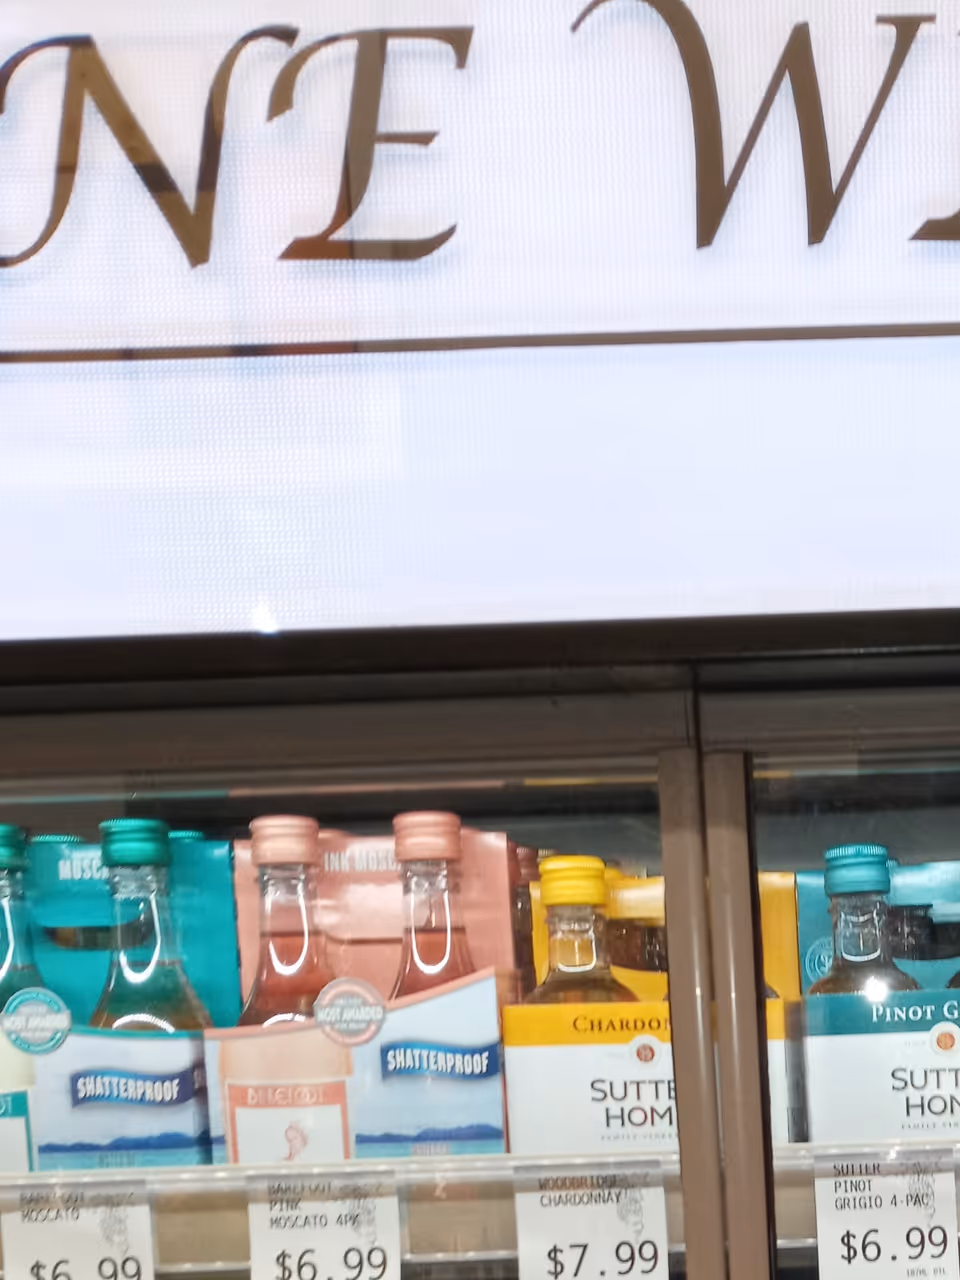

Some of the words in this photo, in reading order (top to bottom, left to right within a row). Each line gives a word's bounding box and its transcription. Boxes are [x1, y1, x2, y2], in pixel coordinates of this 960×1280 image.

[871, 1003, 935, 1022] PINOT
[387, 1049, 489, 1074] SHATTERPROOF
[77, 1076, 180, 1101] SHATTERPROOF
[834, 1179, 872, 1194] PINOT
[540, 1191, 621, 1208] CHARDONNAY
[834, 1195, 883, 1211] GRIGIO
[840, 1225, 948, 1264] $6.99
[547, 1240, 659, 1280] $7.99
